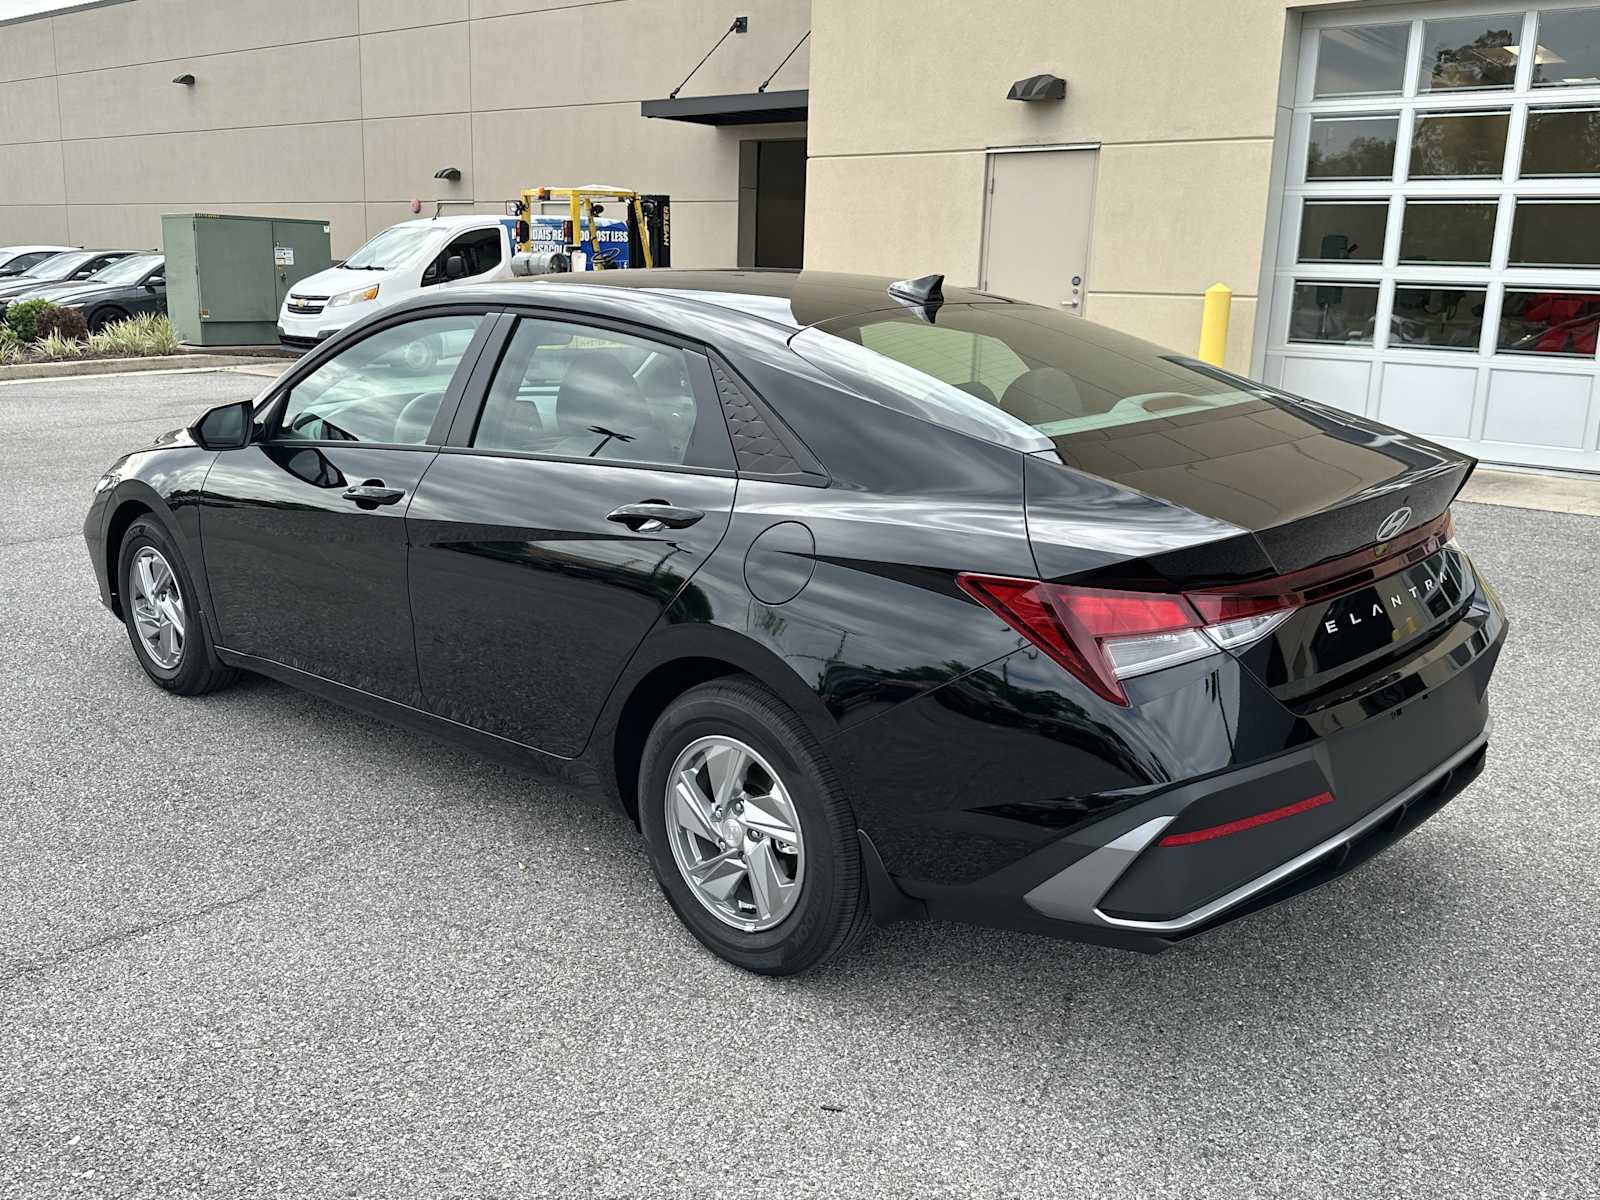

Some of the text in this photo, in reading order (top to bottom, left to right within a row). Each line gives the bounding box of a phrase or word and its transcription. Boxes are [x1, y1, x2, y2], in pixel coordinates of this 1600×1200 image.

[591, 230, 610, 242] OST
[610, 230, 629, 243] LESS
[1324, 571, 1448, 634] ELANTRA
